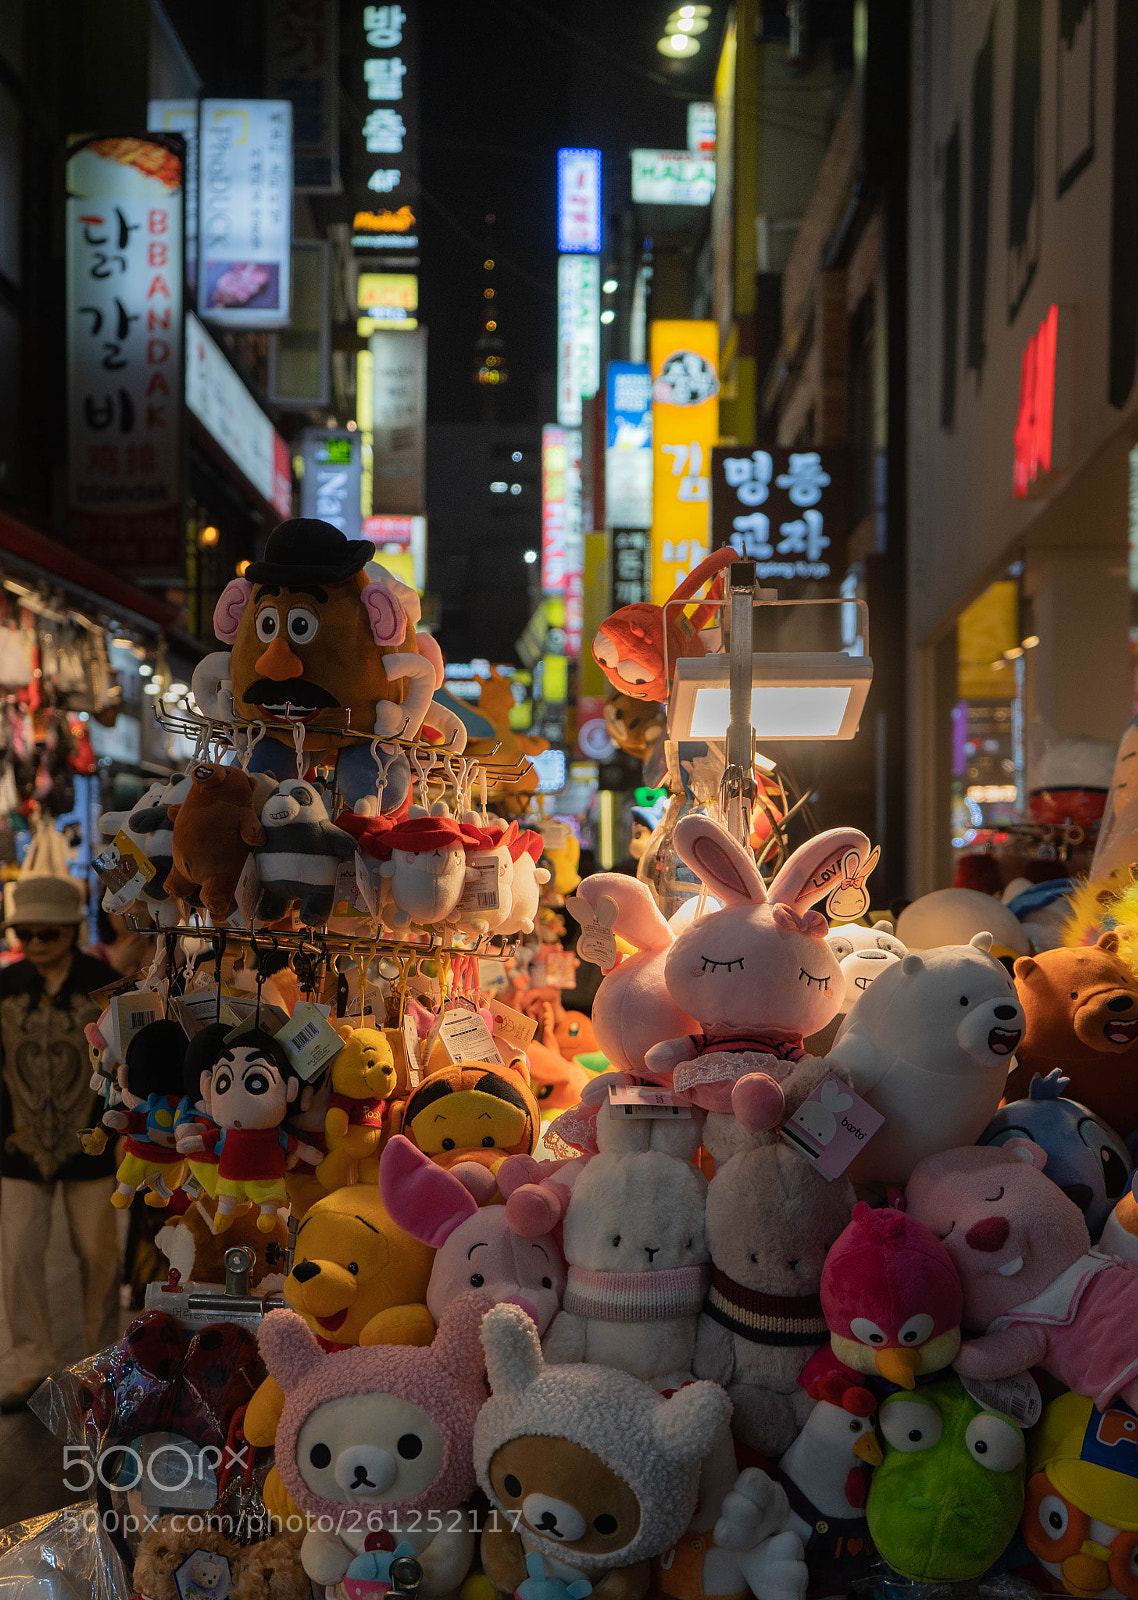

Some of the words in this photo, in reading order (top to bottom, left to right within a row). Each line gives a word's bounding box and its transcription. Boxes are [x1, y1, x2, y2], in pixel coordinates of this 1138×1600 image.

[78, 207, 139, 434] 닭갈비
[147, 209, 170, 430] BBANDAK
[723, 450, 831, 507] 명동
[841, 1116, 865, 1140] booto
